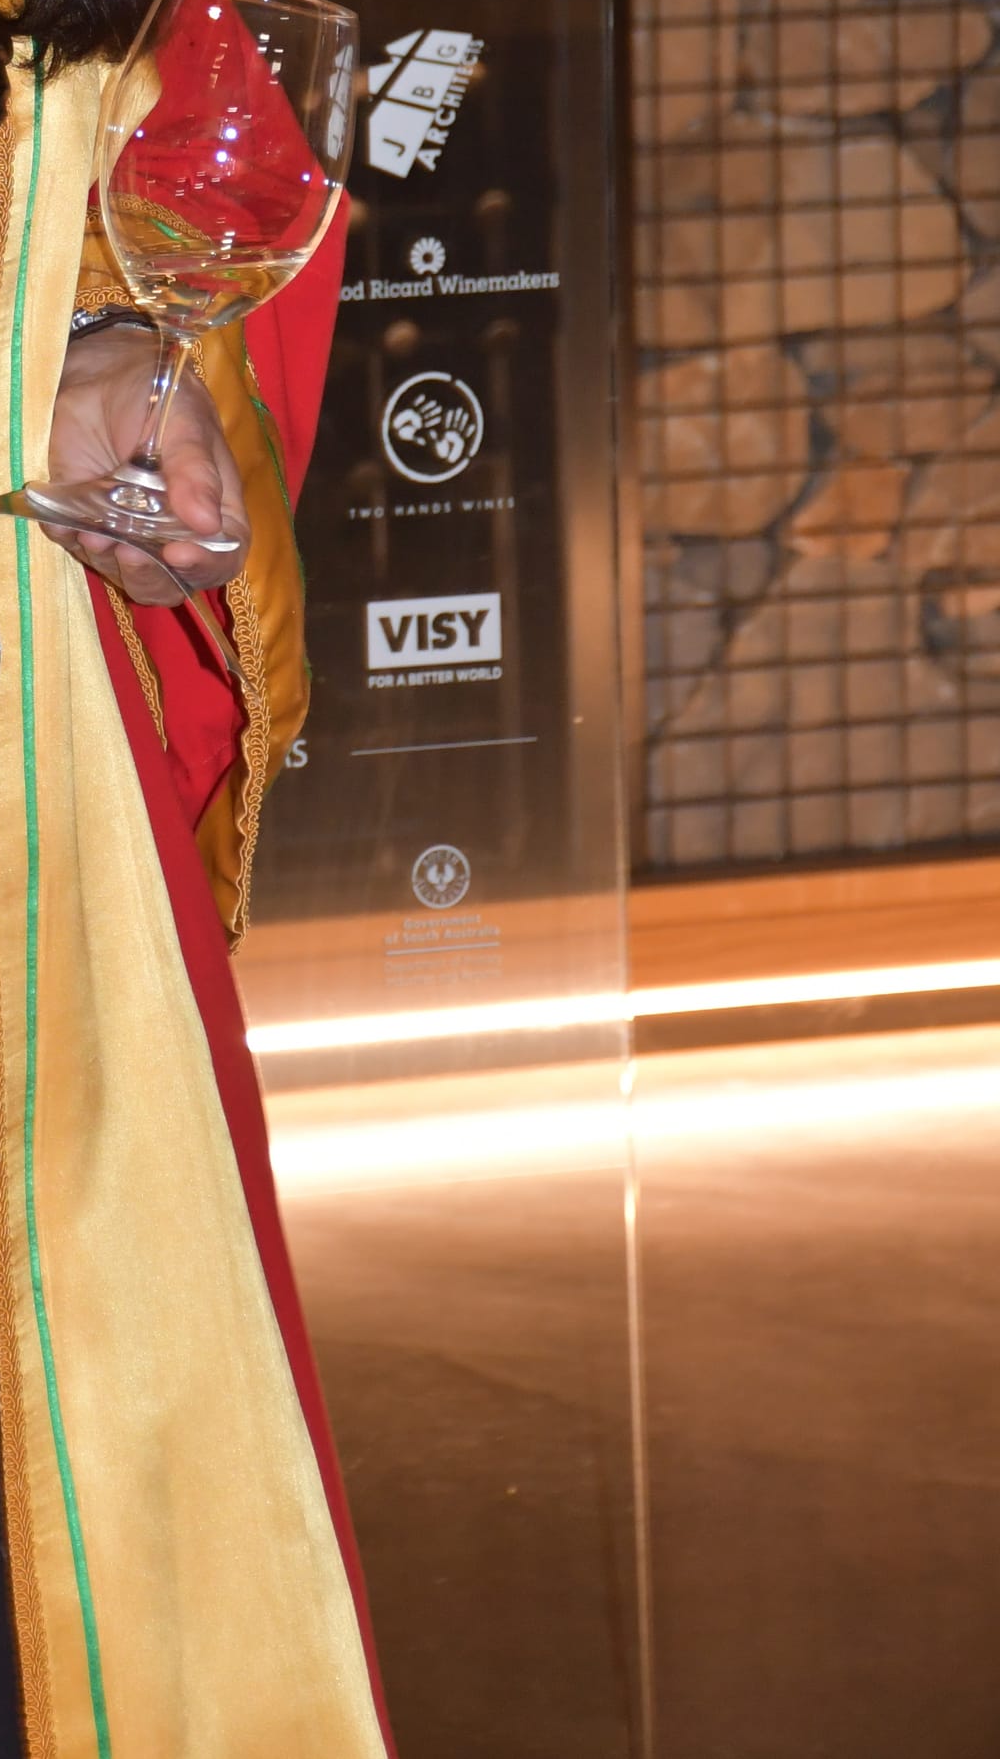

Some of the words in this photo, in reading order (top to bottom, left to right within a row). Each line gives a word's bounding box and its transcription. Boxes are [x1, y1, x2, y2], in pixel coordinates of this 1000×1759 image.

[370, 276, 433, 300] Ricard
[438, 270, 560, 295] Winemakers
[349, 506, 385, 520] TWO
[394, 501, 452, 516] HANDS
[462, 496, 515, 511] WINES
[378, 609, 490, 653] VISY
[368, 675, 394, 689] FOR
[396, 673, 406, 687] A
[408, 670, 454, 686] BETTER
[456, 666, 502, 682] WORLD
